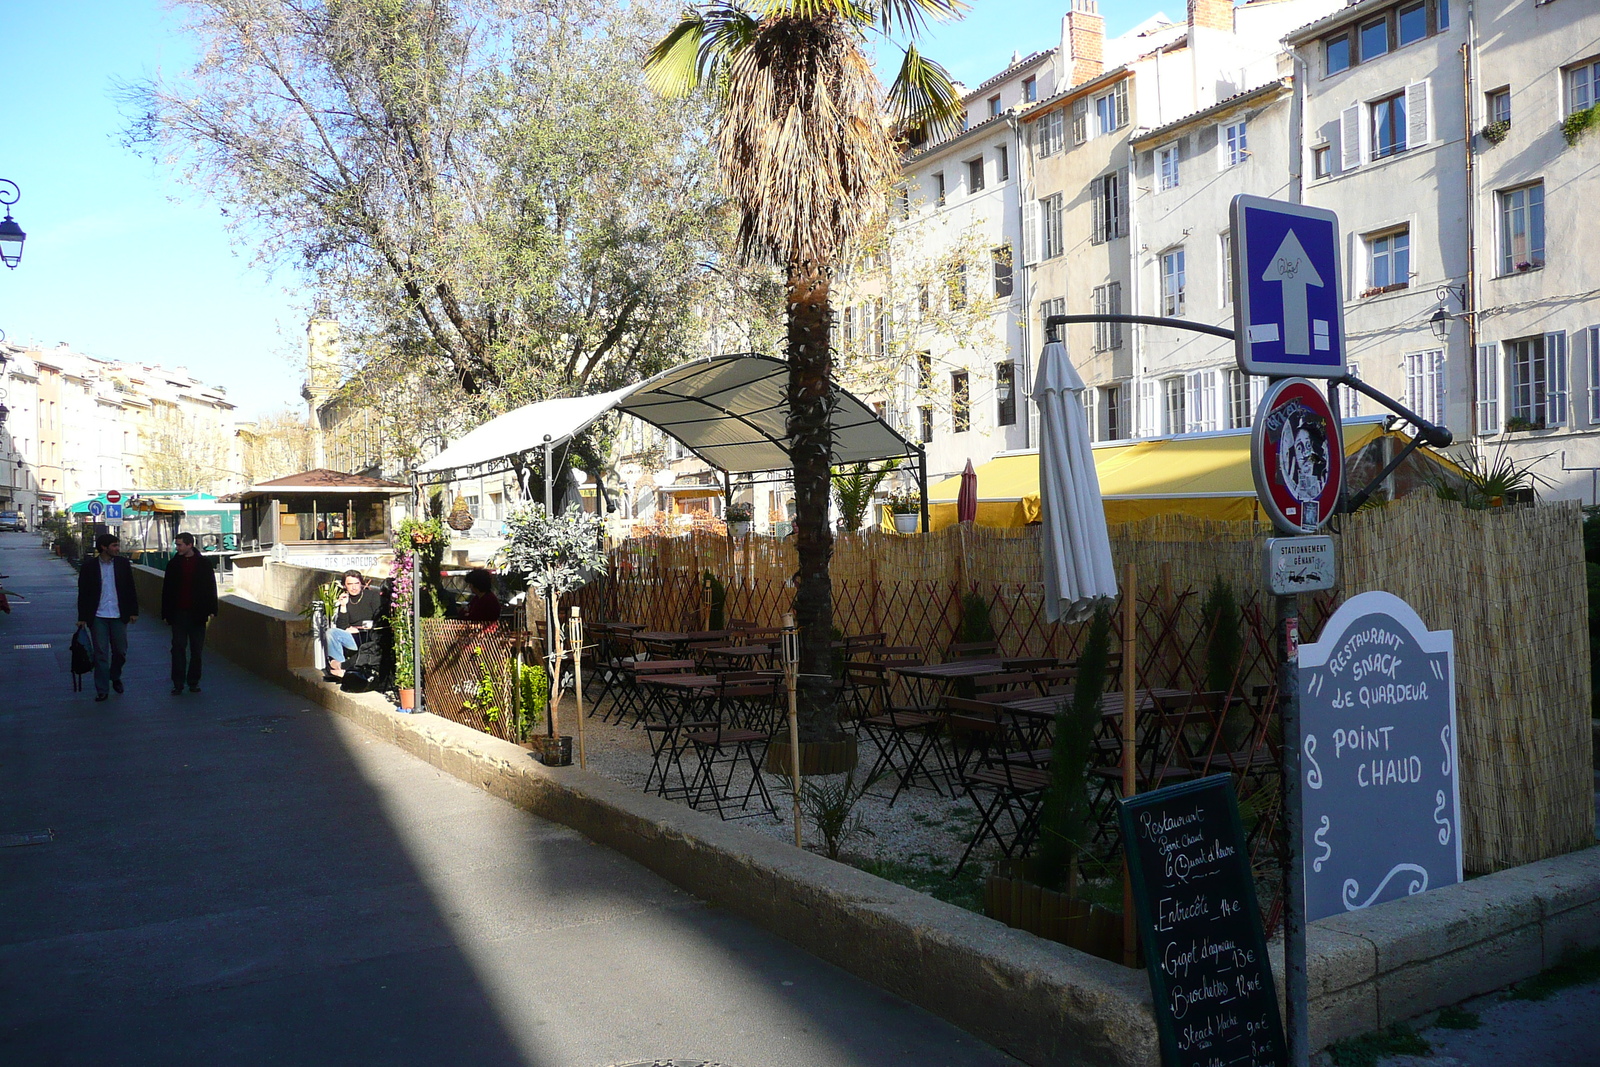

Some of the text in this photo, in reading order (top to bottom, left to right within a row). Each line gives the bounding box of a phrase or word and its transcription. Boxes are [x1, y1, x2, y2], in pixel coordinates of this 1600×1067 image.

[325, 557, 338, 568] DES
[342, 556, 378, 567] CARDEURS
[1281, 544, 1326, 555] STATIONNEMENT
[1294, 556, 1315, 565] GÊNANT
[1330, 628, 1404, 678] RESTAURANT
[1353, 653, 1402, 682] SNACK
[1332, 681, 1429, 709] LE QUARDEUR
[1357, 755, 1422, 788] CHAUD
[1140, 805, 1204, 843] Restaurant
[1159, 894, 1209, 932] Entrecôte
[1165, 939, 1199, 979] Gigot
